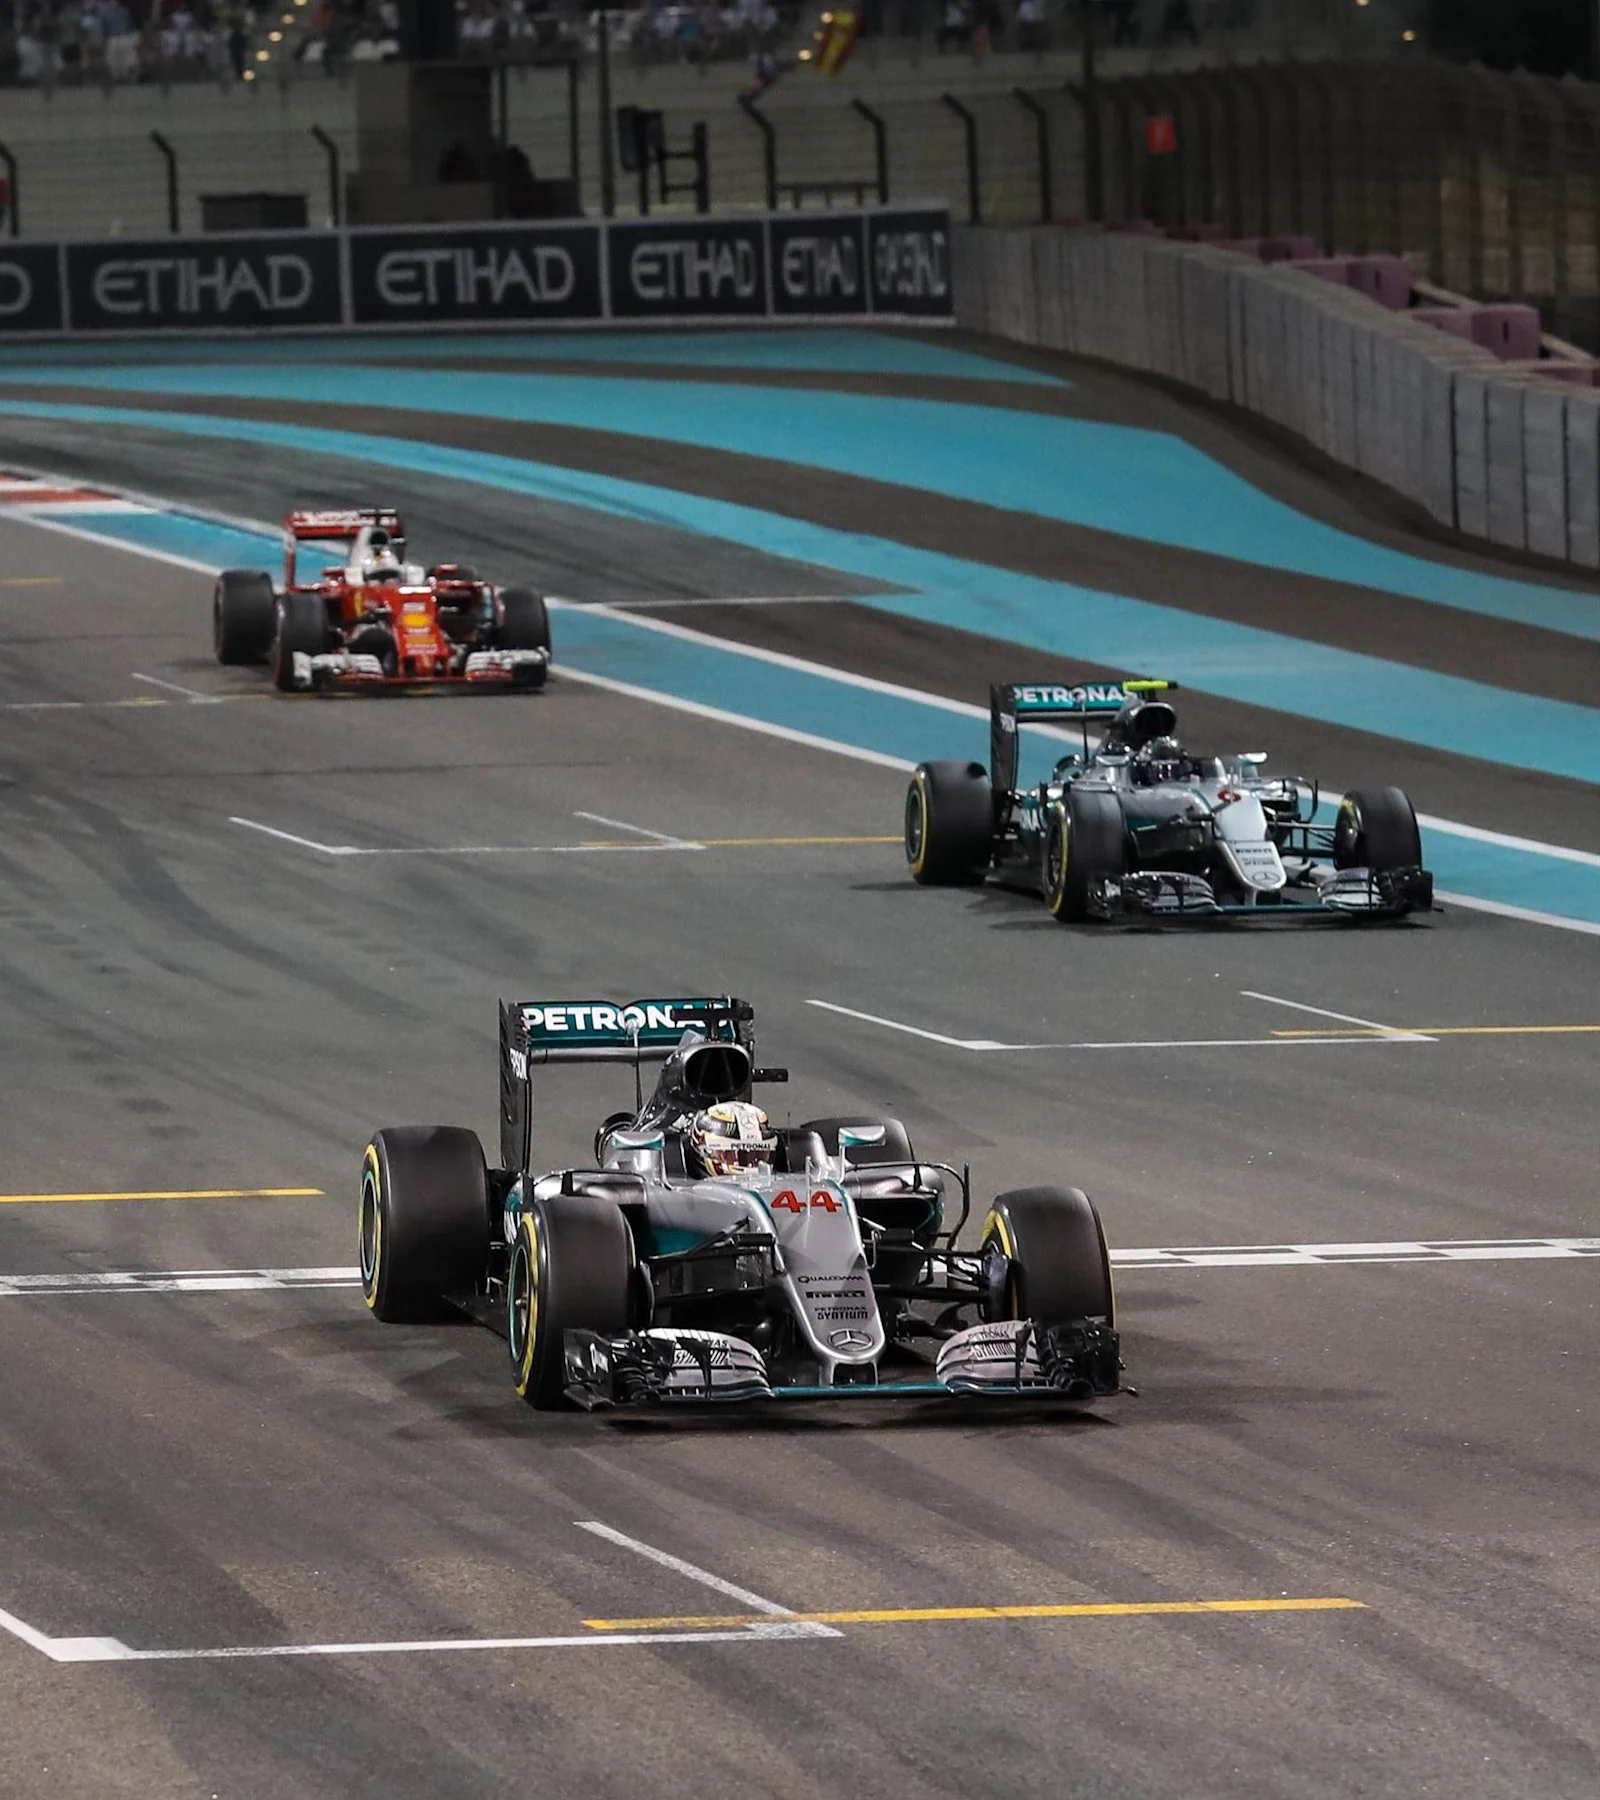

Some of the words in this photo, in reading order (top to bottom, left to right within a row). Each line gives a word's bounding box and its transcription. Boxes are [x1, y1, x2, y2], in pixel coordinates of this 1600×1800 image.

[94, 254, 313, 314] ETIHAD
[376, 246, 574, 306] ETIHAD
[630, 238, 756, 299] ETIHAD
[770, 1190, 843, 1213] 44
